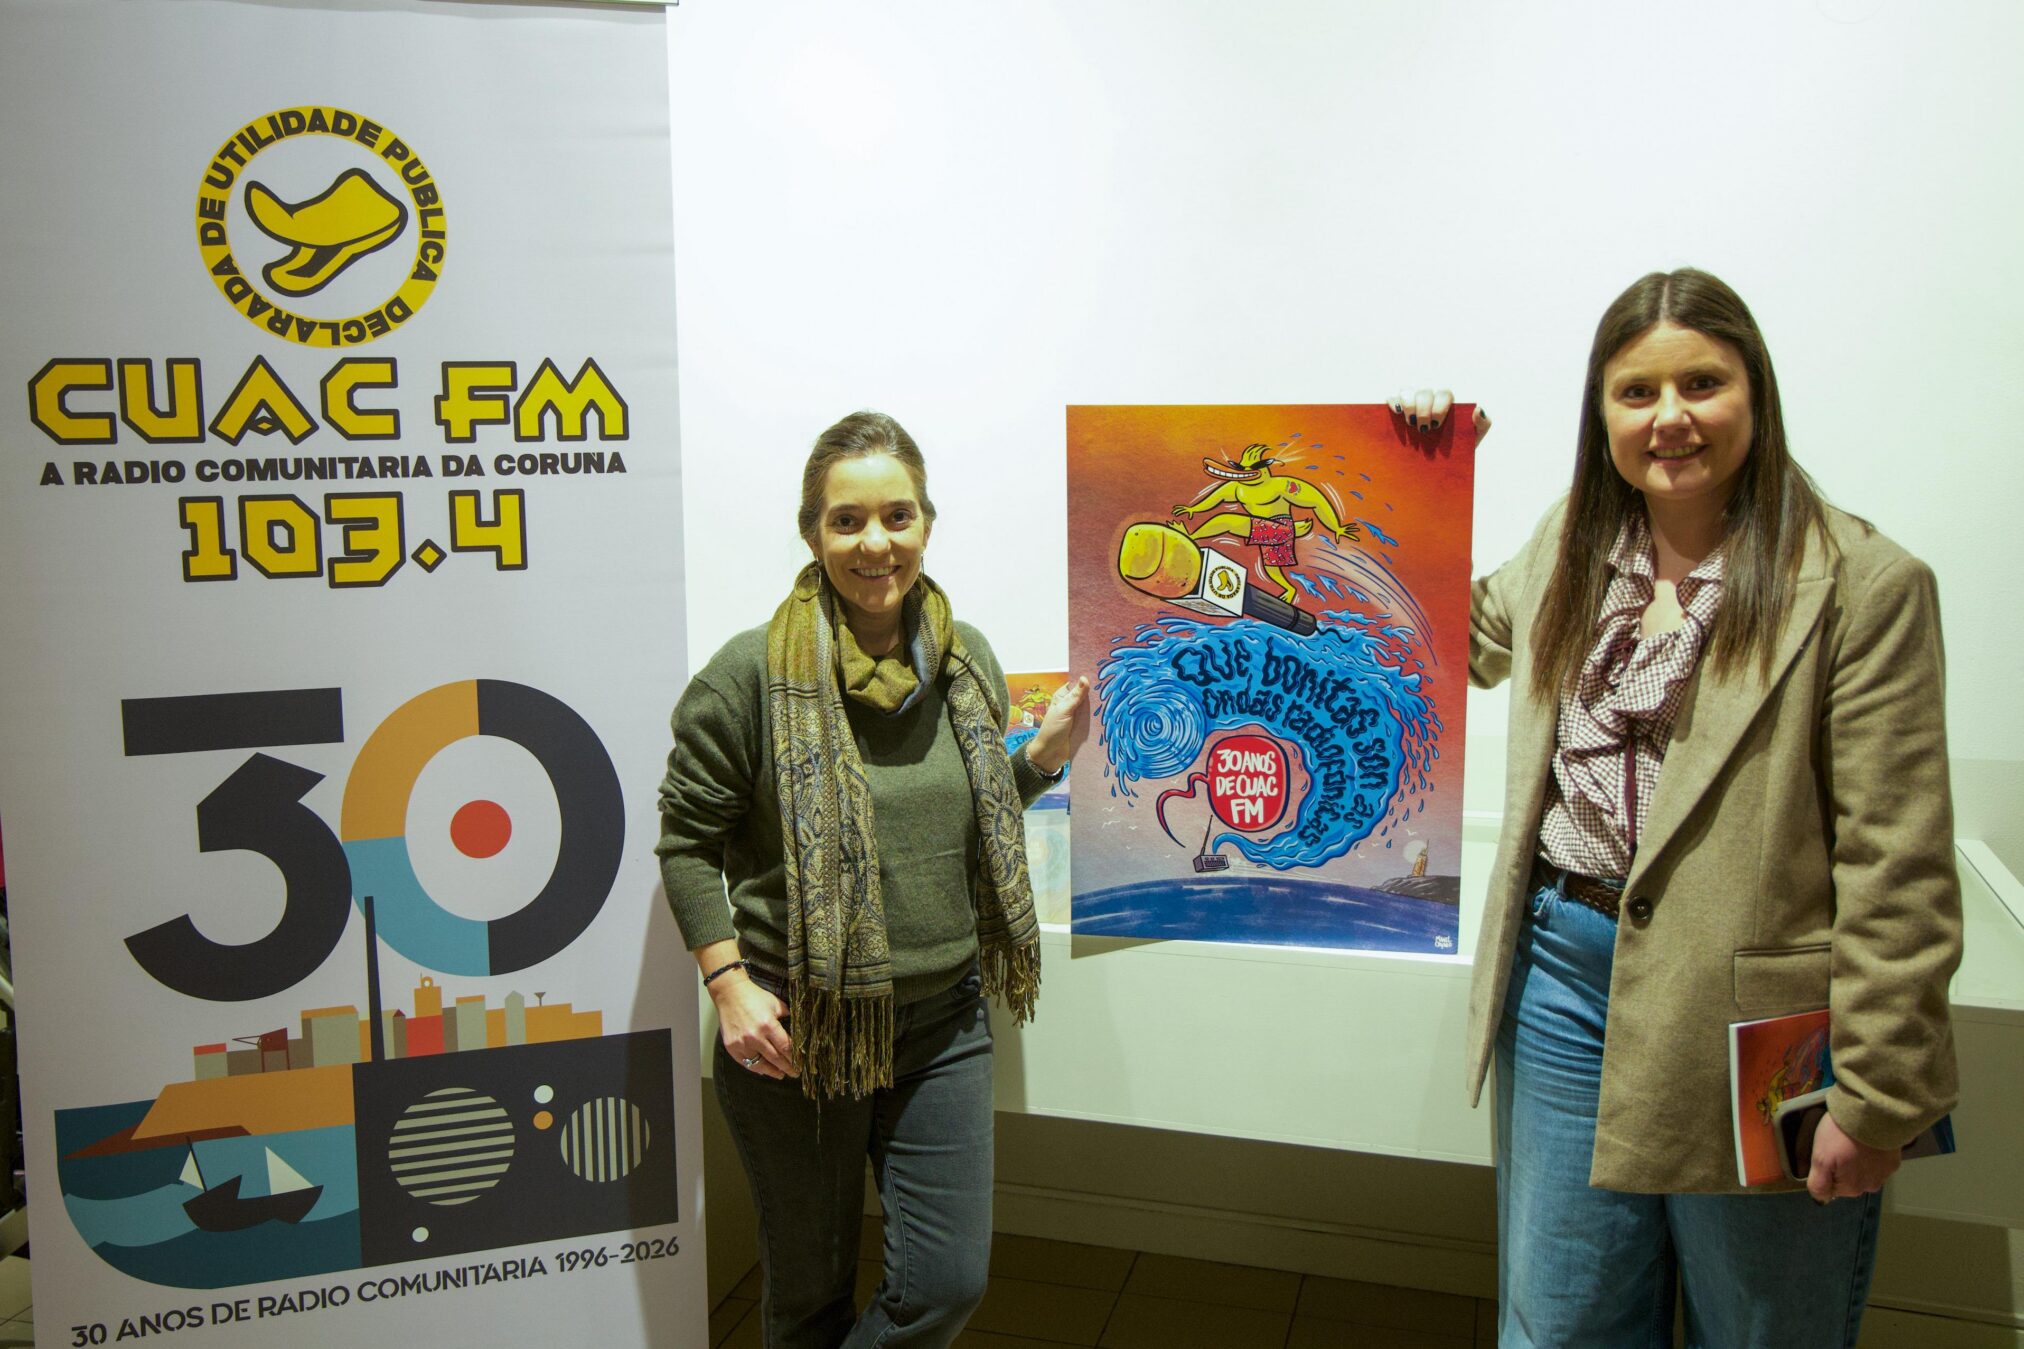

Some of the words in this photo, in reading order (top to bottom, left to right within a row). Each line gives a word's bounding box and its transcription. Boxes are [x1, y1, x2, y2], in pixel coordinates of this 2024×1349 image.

[205, 108, 382, 190] UTILIDADE
[199, 197, 227, 246] DE
[211, 253, 413, 346] DECLARADA
[28, 355, 400, 447] CUAC
[434, 358, 629, 443] FM
[39, 463, 64, 486] A
[73, 459, 186, 484] RADIO
[196, 455, 433, 481] COMUNITARIA
[442, 454, 486, 478] DA
[179, 489, 527, 588] 103.4
[1202, 672, 1285, 722] ondas
[1261, 636, 1381, 739] bonitas
[1216, 776, 1236, 797] DE
[1217, 749, 1242, 773] 30
[1241, 751, 1277, 775] ANOS
[1352, 738, 1391, 790] son
[1231, 797, 1265, 824] FM
[1343, 794, 1375, 830] as
[122, 678, 626, 1003] 30
[71, 1323, 108, 1348] 30
[116, 1306, 205, 1342] ANOS
[211, 1299, 251, 1325] DE
[258, 1285, 350, 1318] RADIO
[357, 1256, 548, 1302] COMUNITARIA
[555, 1236, 680, 1272] 1996-2026
